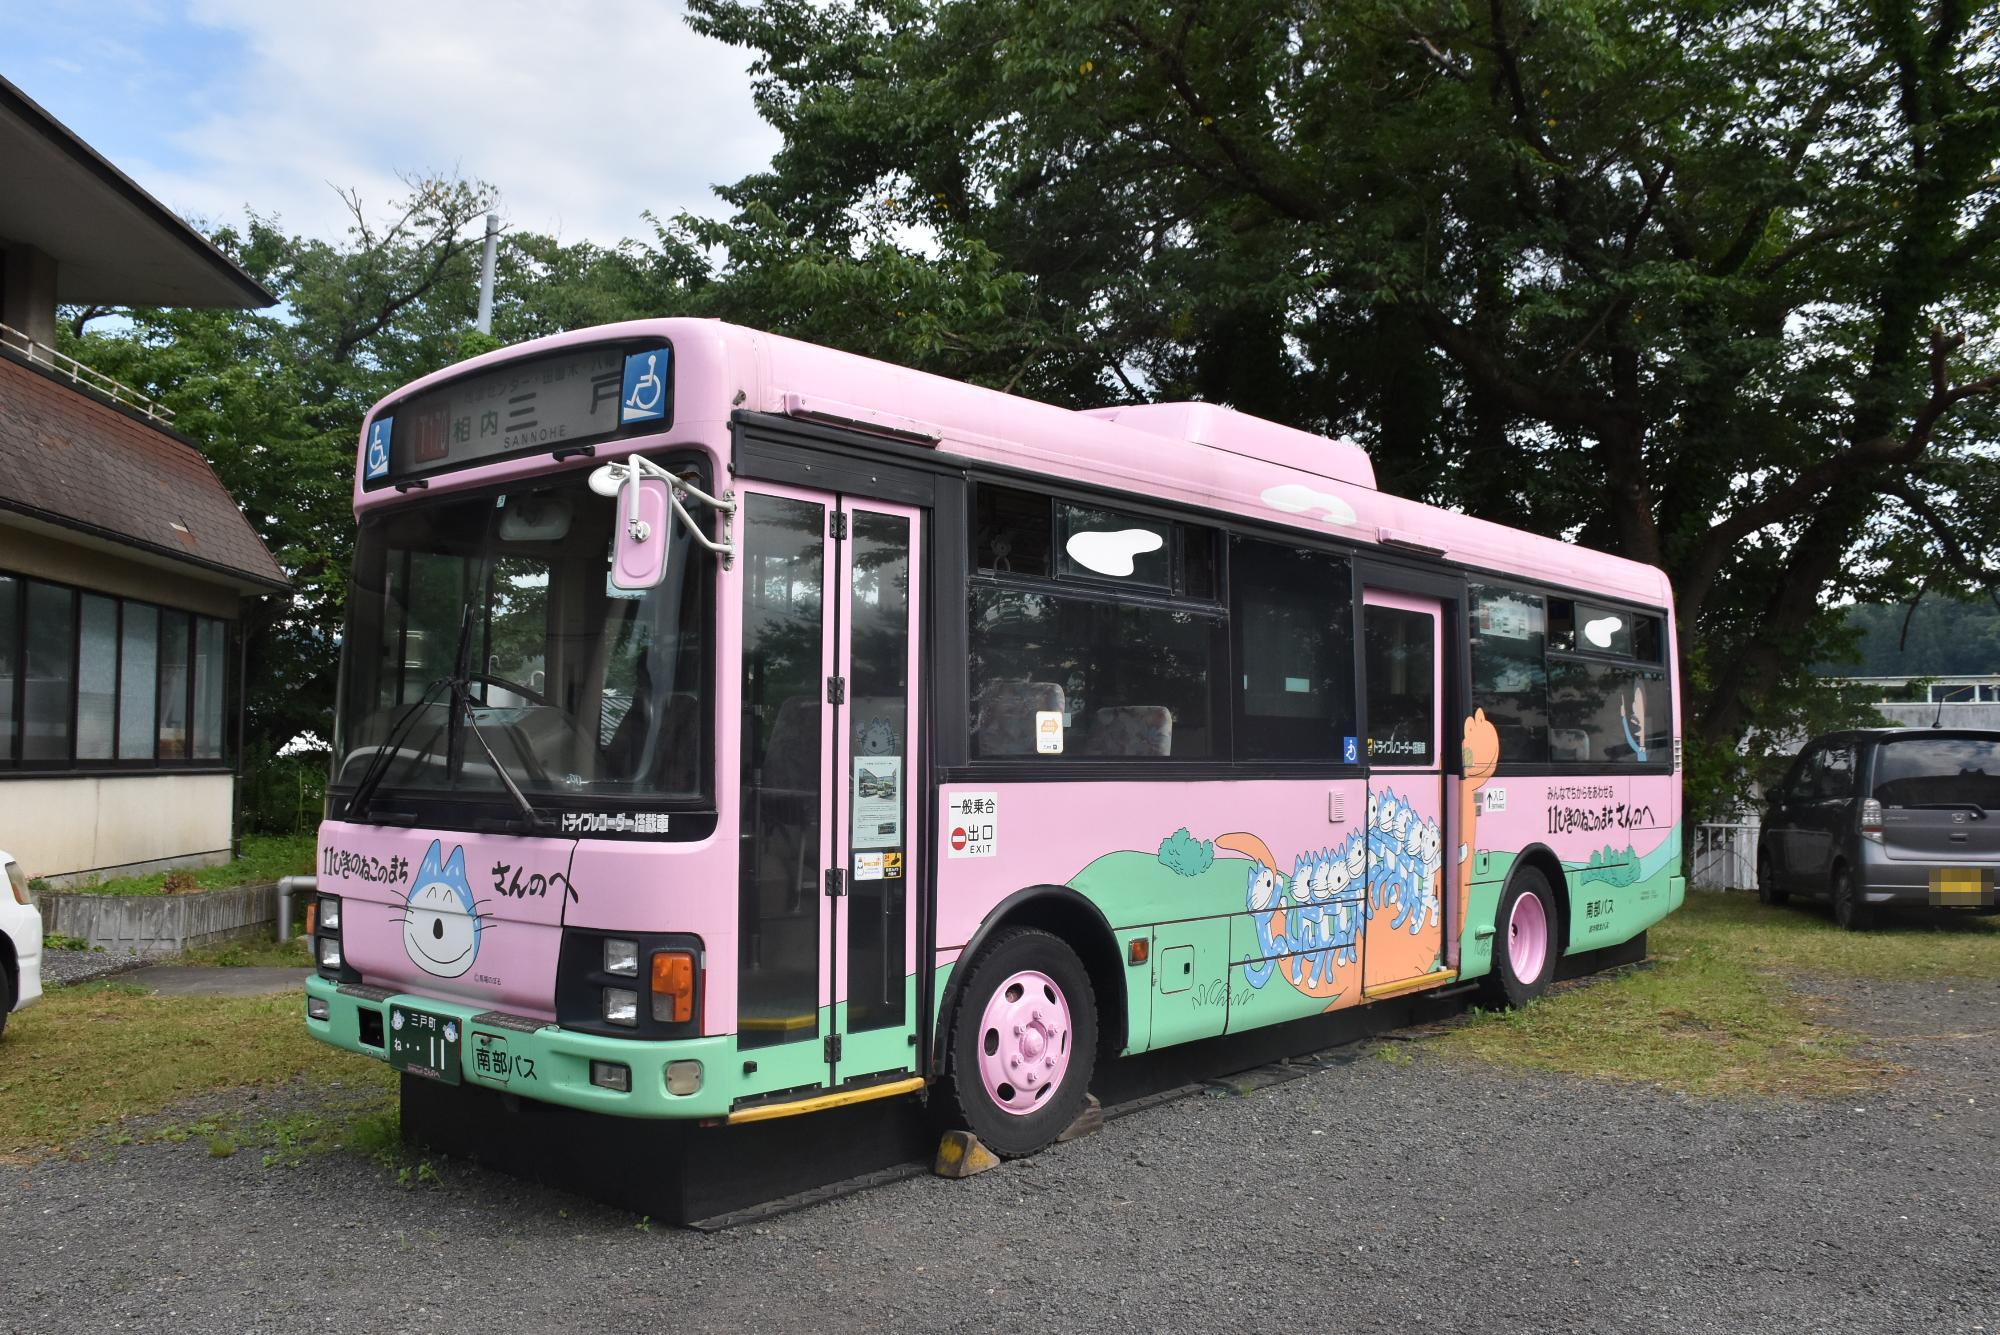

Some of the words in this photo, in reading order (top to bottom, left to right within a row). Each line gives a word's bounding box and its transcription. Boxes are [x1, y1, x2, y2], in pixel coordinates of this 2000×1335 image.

[453, 410, 499, 443] 相内
[504, 424, 567, 449] SANNOHE
[1547, 785, 1614, 800] みんなでちからをあわせる
[950, 798, 995, 815] 一般乗合
[1616, 801, 1655, 829] さんのへ
[561, 812, 670, 833] ドライブレコーダー搭載車
[968, 824, 993, 842] 出口
[970, 844, 992, 854] EXIT
[323, 846, 409, 885] 11ぴきのねこのまち
[491, 860, 579, 904] さんのへ
[1586, 898, 1614, 919] 南部バス
[410, 1013, 437, 1032] 三戸町
[394, 1037, 402, 1051] ね
[476, 1047, 538, 1081] 南部バス
